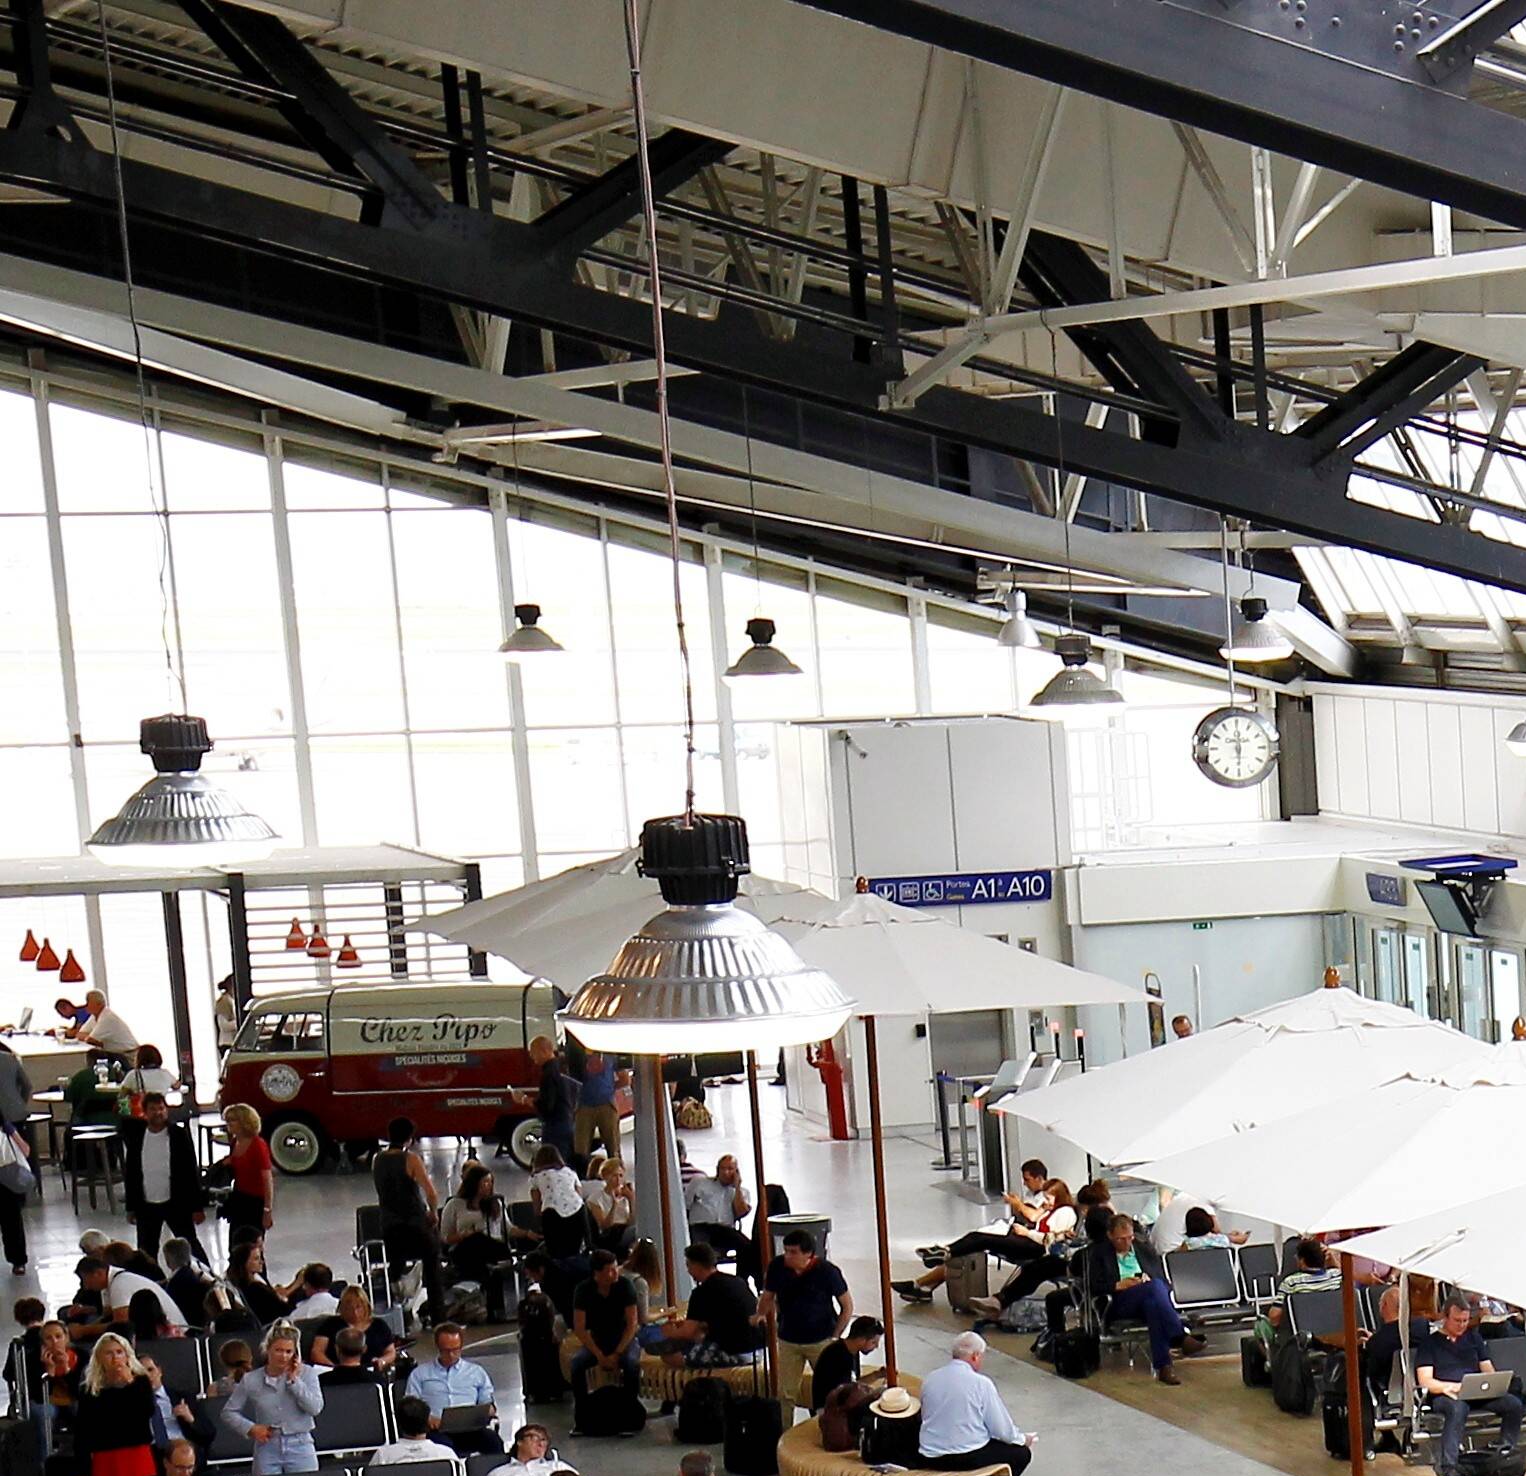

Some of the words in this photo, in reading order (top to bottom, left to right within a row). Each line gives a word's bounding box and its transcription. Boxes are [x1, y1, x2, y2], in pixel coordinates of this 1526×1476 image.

[971, 878, 995, 899] A1
[1006, 875, 1045, 897] A10
[360, 1017, 424, 1044] Chez
[432, 1013, 498, 1047] Pipo
